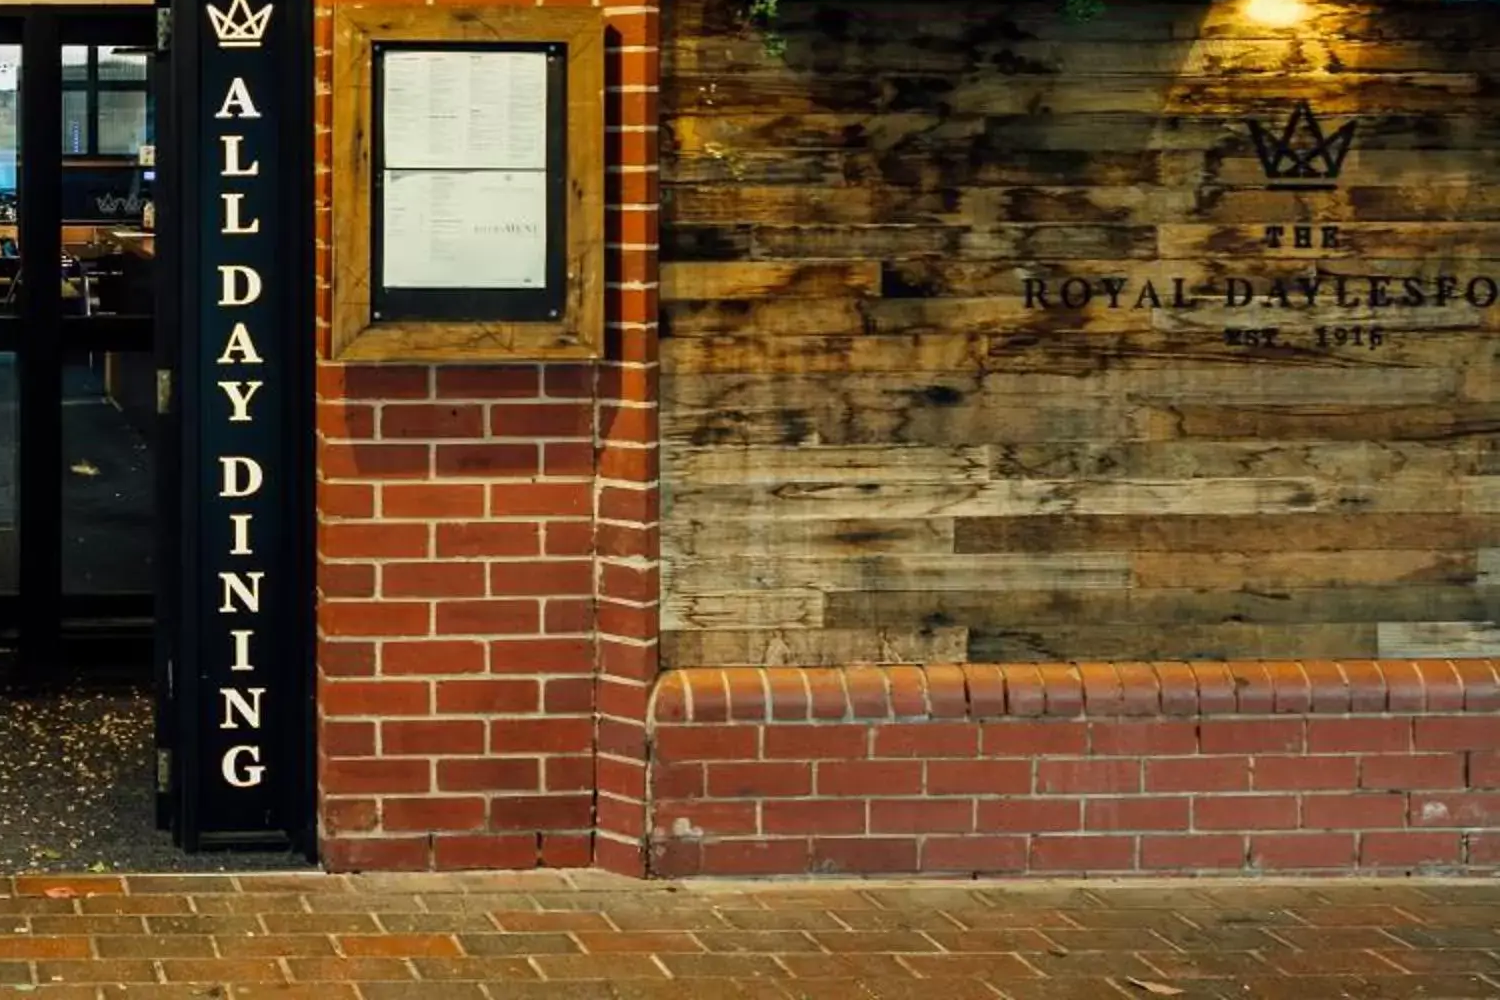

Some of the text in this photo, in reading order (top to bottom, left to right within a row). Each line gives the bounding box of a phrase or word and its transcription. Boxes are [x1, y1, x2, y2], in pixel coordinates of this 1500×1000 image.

[1265, 225, 1340, 248] THE
[1023, 276, 1198, 309] ROYAL
[214, 76, 267, 788] ALL DAY DINING
